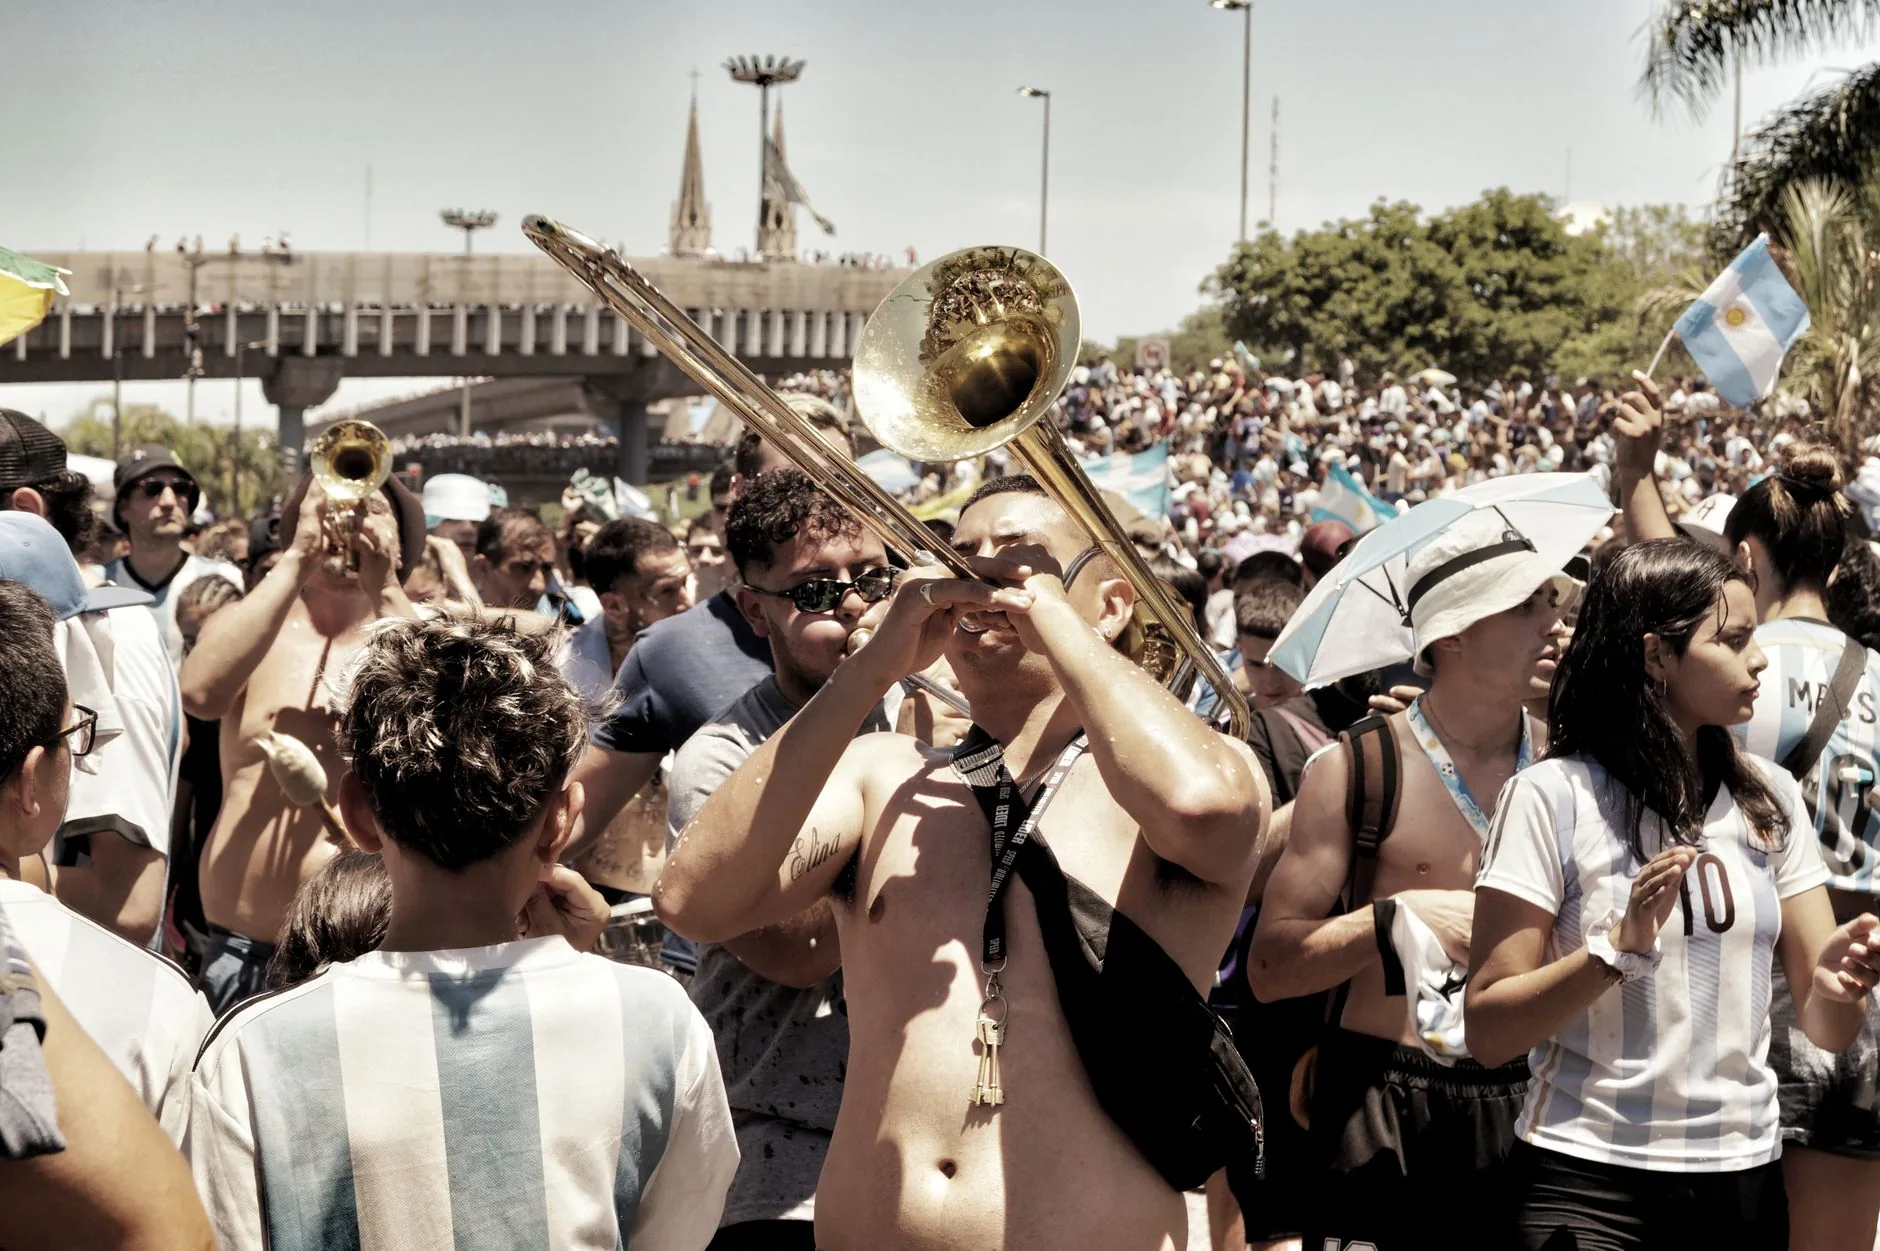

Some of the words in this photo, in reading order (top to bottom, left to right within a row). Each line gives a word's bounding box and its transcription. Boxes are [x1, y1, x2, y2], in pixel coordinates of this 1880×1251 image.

[1788, 677, 1877, 724] MES
[994, 804, 1010, 828] LIDER
[1011, 819, 1036, 845] LIDER
[1680, 853, 1736, 936] 10
